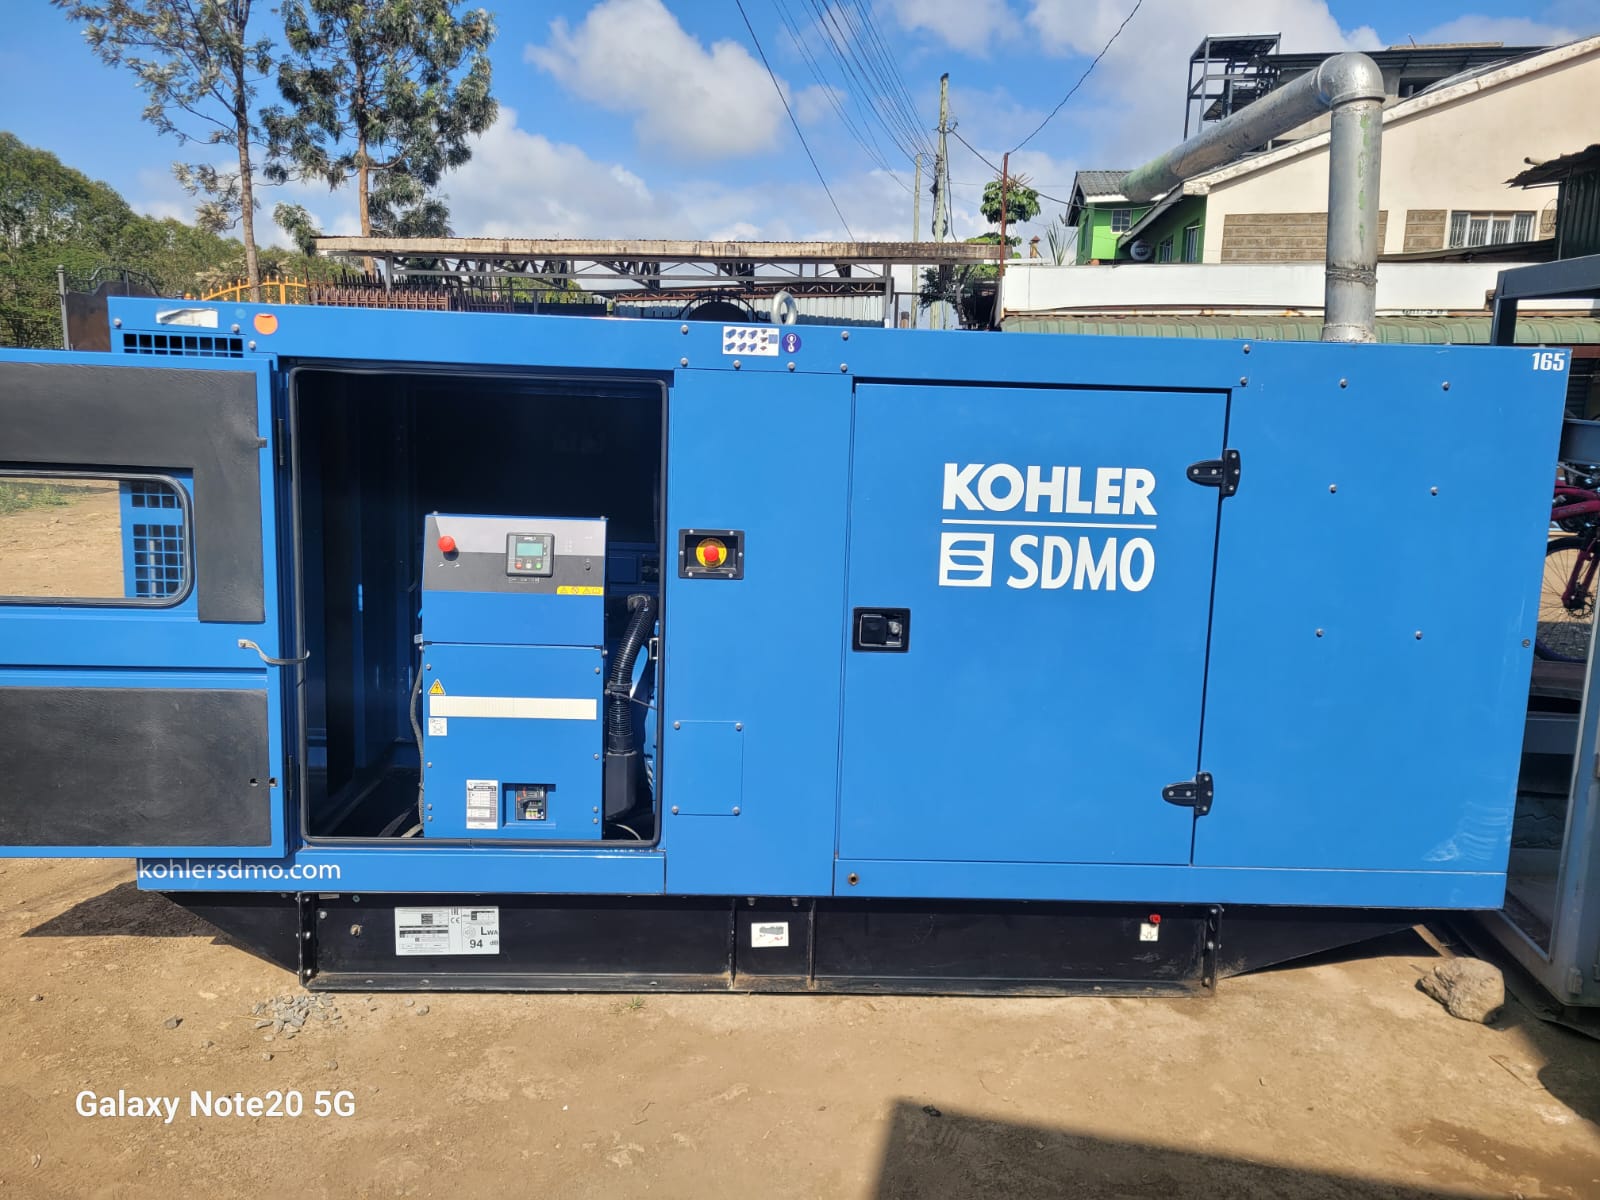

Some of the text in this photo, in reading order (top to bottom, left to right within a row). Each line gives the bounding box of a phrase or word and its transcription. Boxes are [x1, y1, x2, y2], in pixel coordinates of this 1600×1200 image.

[1531, 351, 1566, 371] 165
[942, 463, 1158, 515] KOHLER
[1007, 534, 1155, 592] SDMO
[139, 859, 341, 880] kohlersdmo.com
[469, 939, 483, 949] 94
